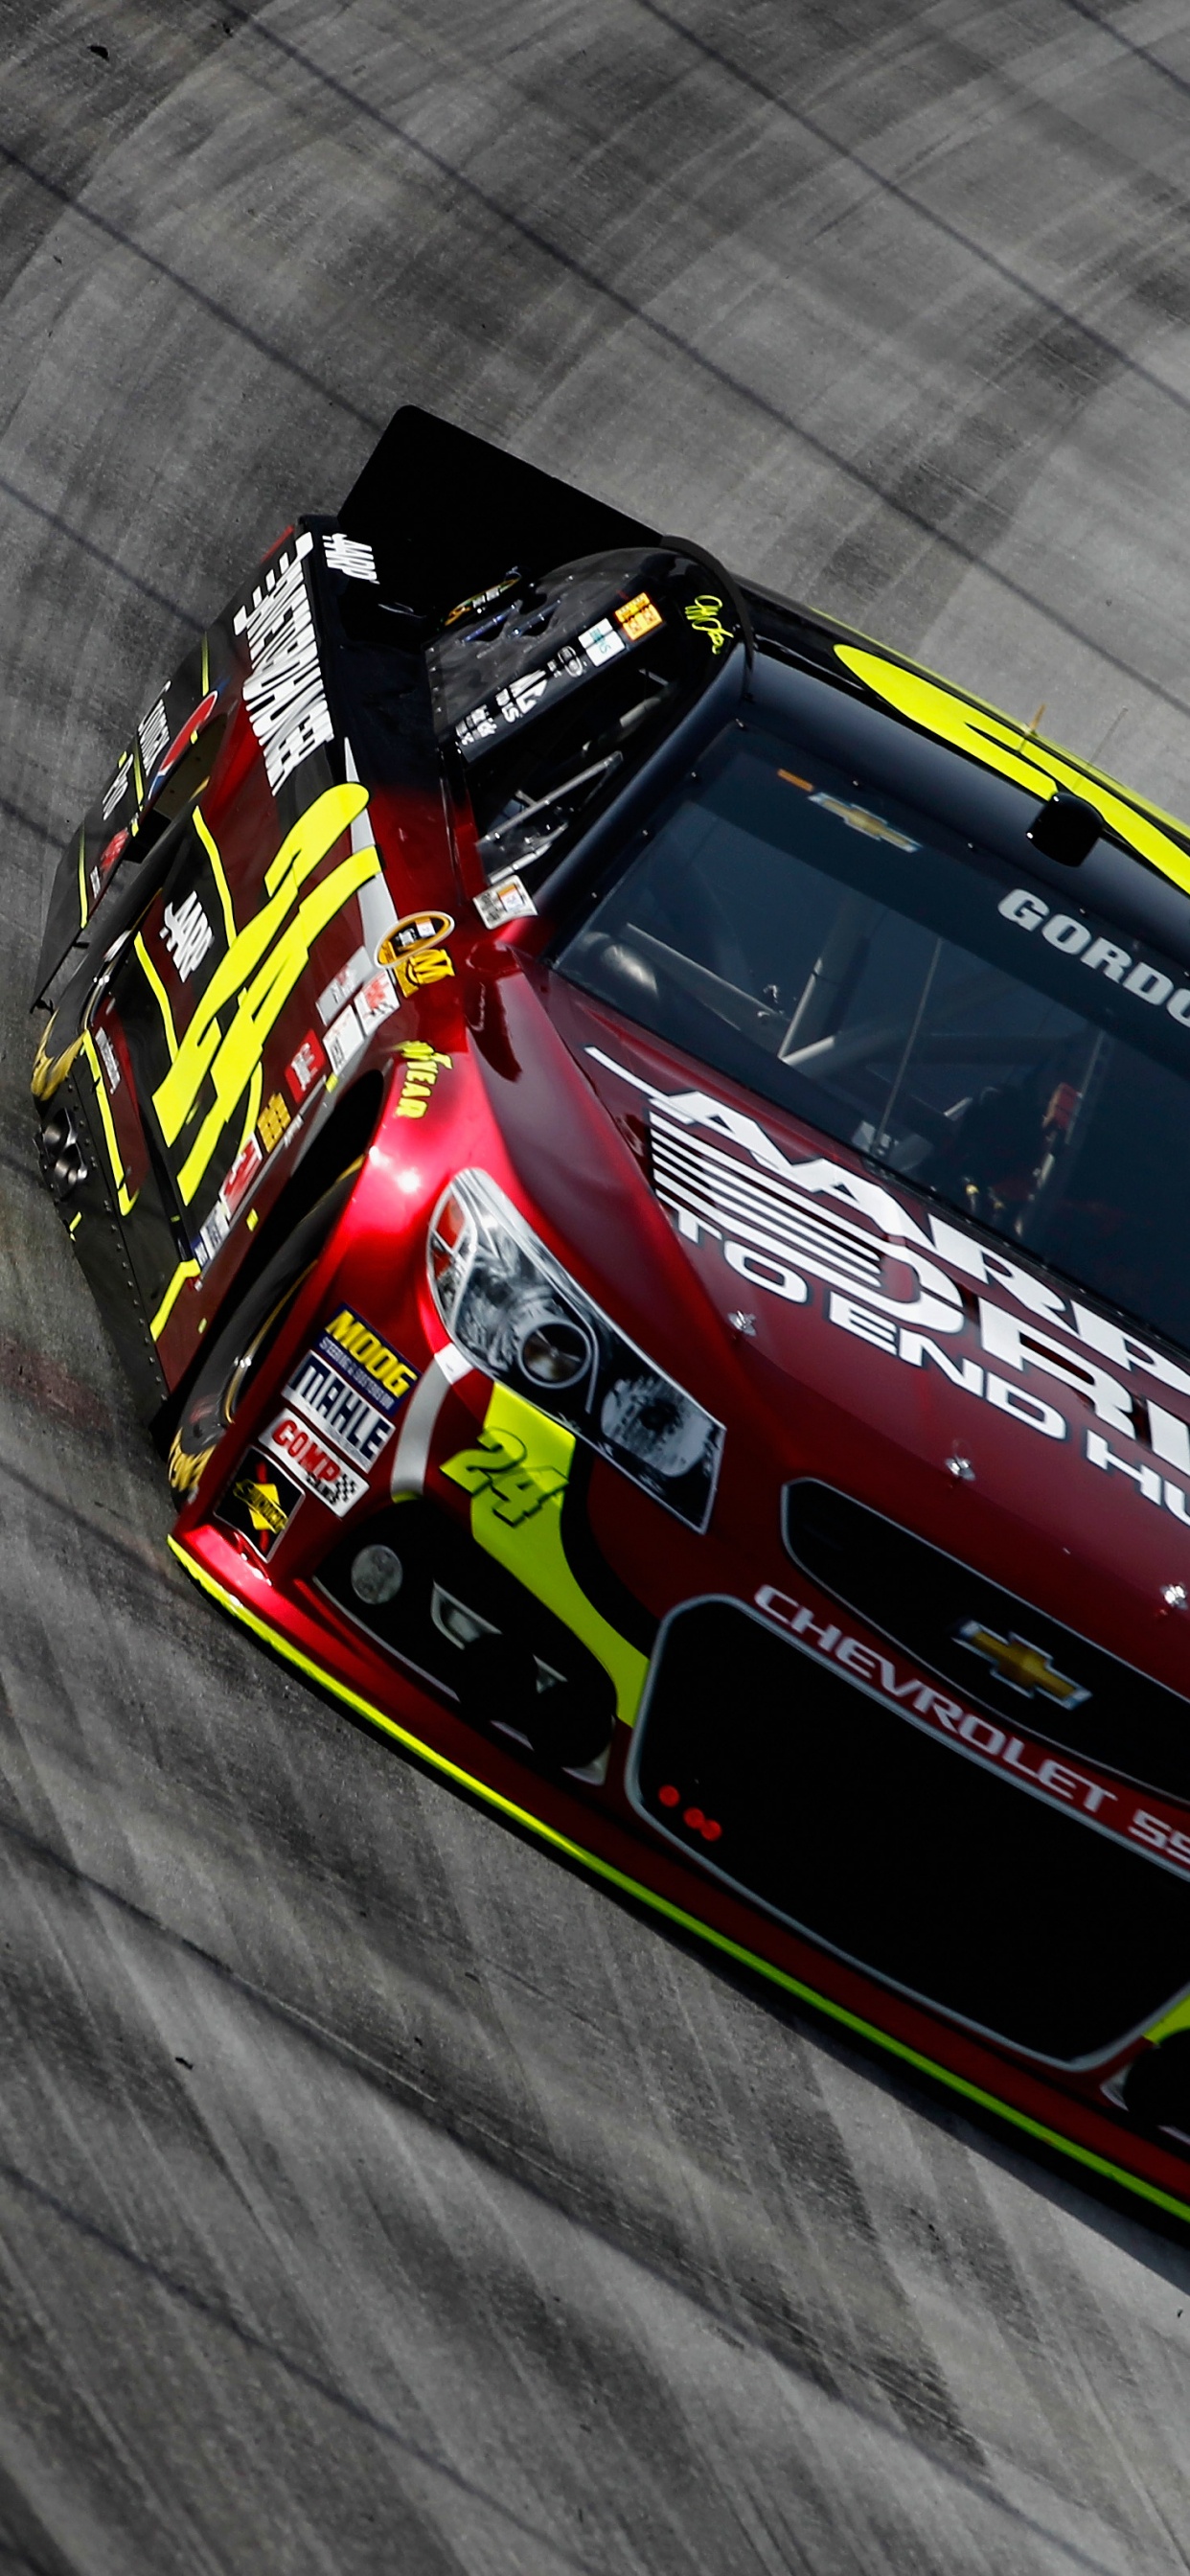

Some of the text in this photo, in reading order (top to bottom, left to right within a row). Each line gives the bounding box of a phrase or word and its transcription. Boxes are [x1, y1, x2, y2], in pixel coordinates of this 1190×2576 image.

[245, 657, 334, 797] HUNGER
[160, 890, 216, 983] AARP
[151, 782, 380, 1207] 24
[392, 1041, 452, 1119] YEAR
[650, 1091, 1190, 1395] AARP
[325, 1309, 418, 1399] MOOG
[673, 1208, 808, 1304] TO
[828, 1290, 1067, 1439] END
[271, 1419, 342, 1483] COMP
[287, 1351, 390, 1461] MAHLE
[439, 1425, 570, 1530] 24
[753, 1583, 1119, 1813] CHEVROLET
